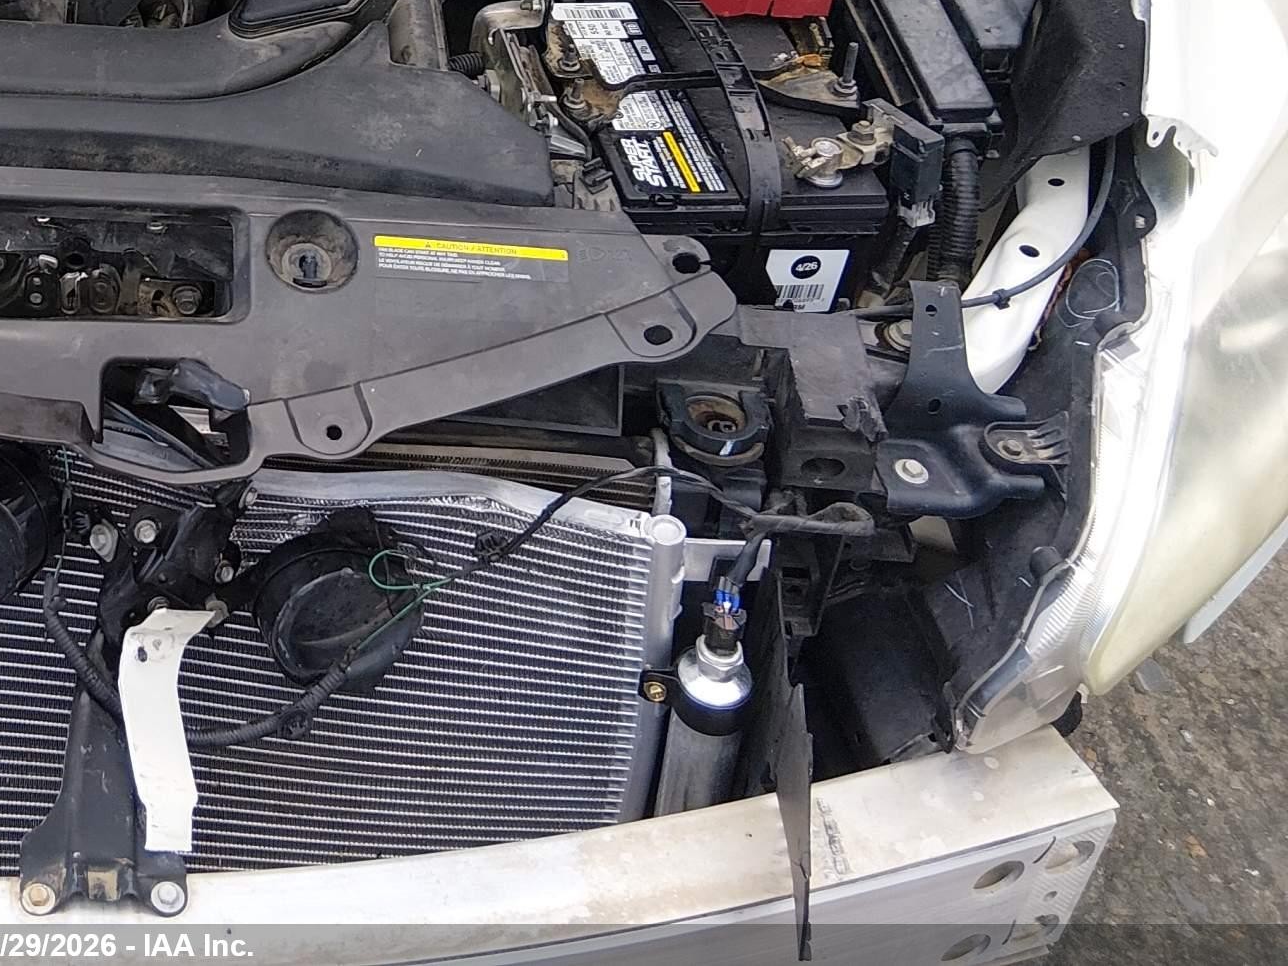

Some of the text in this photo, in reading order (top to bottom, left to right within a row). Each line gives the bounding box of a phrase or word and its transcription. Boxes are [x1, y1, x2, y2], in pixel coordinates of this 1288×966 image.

[619, 137, 645, 182] SUPER
[631, 135, 668, 188] START
[436, 241, 469, 251] CAUTION
[476, 245, 517, 255] ATTENTION
[795, 261, 818, 271] 4/26
